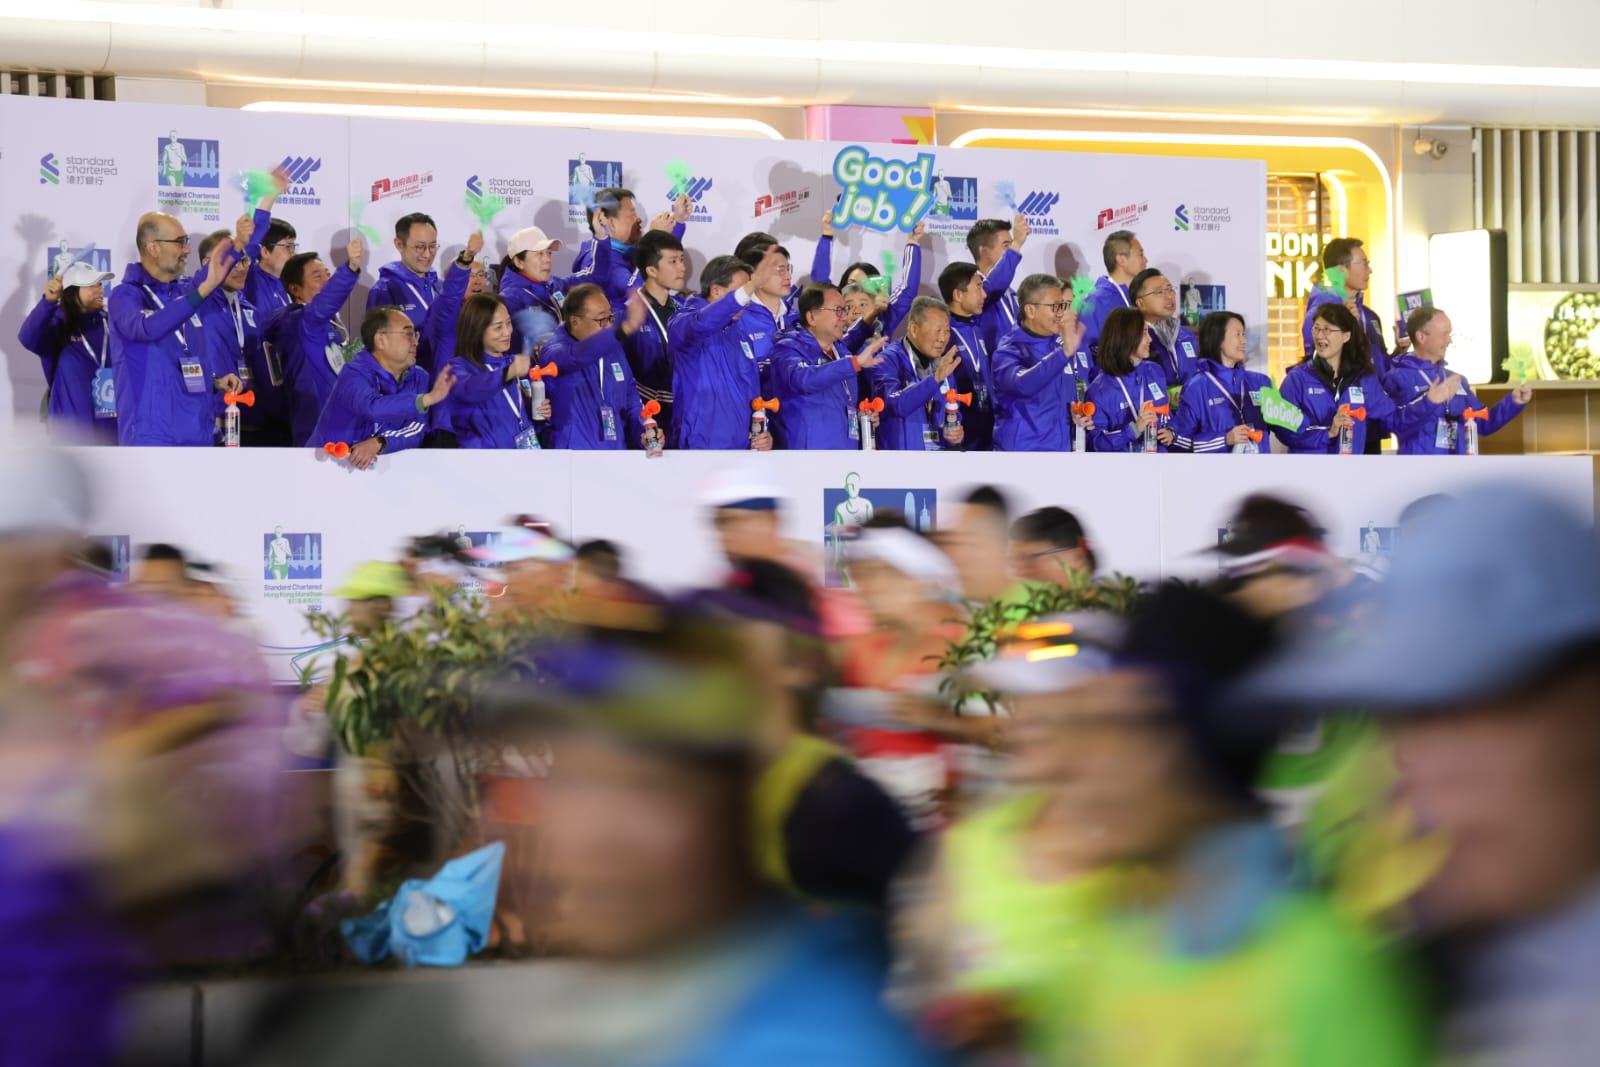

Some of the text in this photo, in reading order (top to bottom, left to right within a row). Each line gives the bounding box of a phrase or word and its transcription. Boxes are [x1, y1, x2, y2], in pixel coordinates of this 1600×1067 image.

[66, 156, 114, 166] standard
[66, 165, 118, 176] chartered
[837, 149, 932, 191] Good
[488, 176, 531, 187] standard
[188, 191, 220, 200] Chartered
[489, 186, 534, 196] chartered
[1193, 206, 1229, 214] standard
[1193, 214, 1231, 222] chartered
